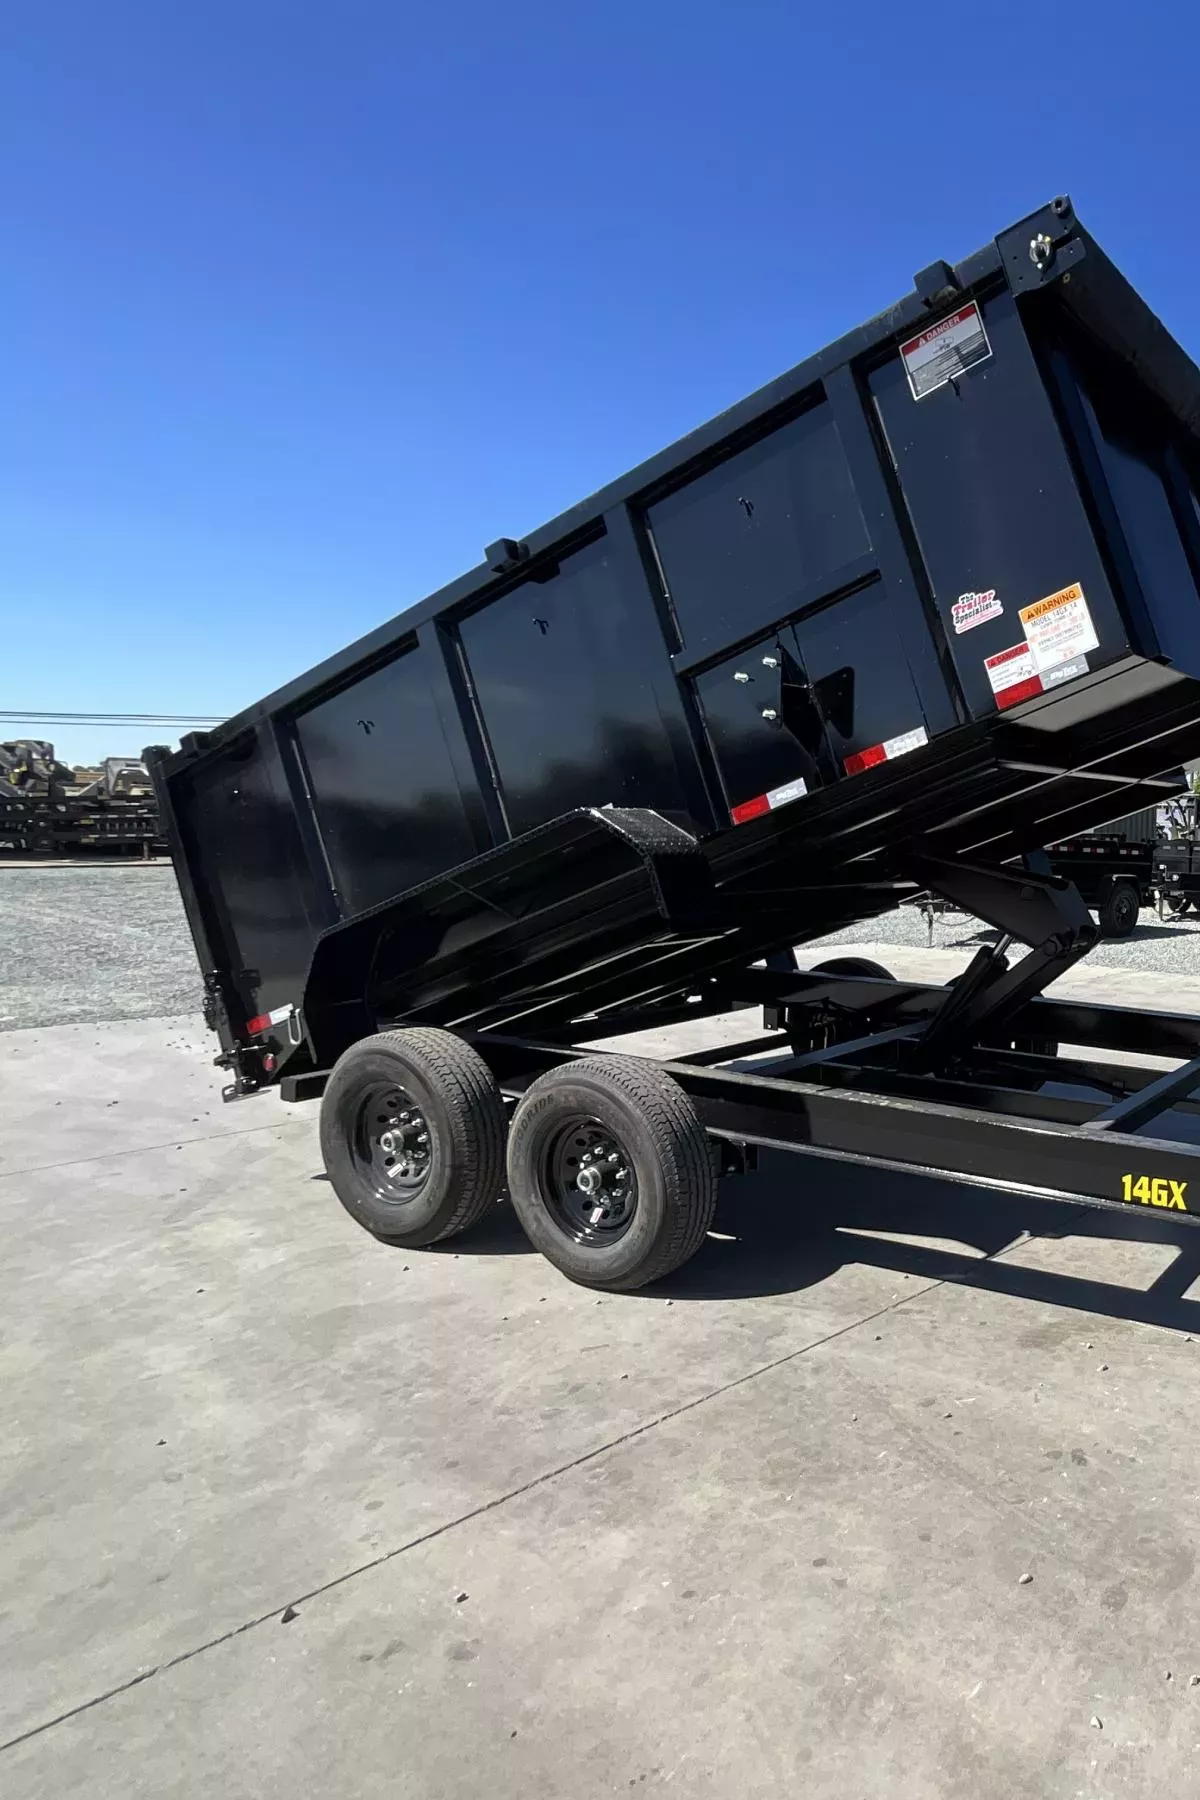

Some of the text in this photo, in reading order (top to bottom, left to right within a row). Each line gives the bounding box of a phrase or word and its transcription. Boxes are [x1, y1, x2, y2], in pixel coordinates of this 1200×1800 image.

[926, 315, 961, 340] DANGER
[953, 591, 993, 616] Trailer
[955, 602, 993, 624] Specialist
[1033, 590, 1076, 616] WARNING
[1121, 1173, 1188, 1211] 14GX
